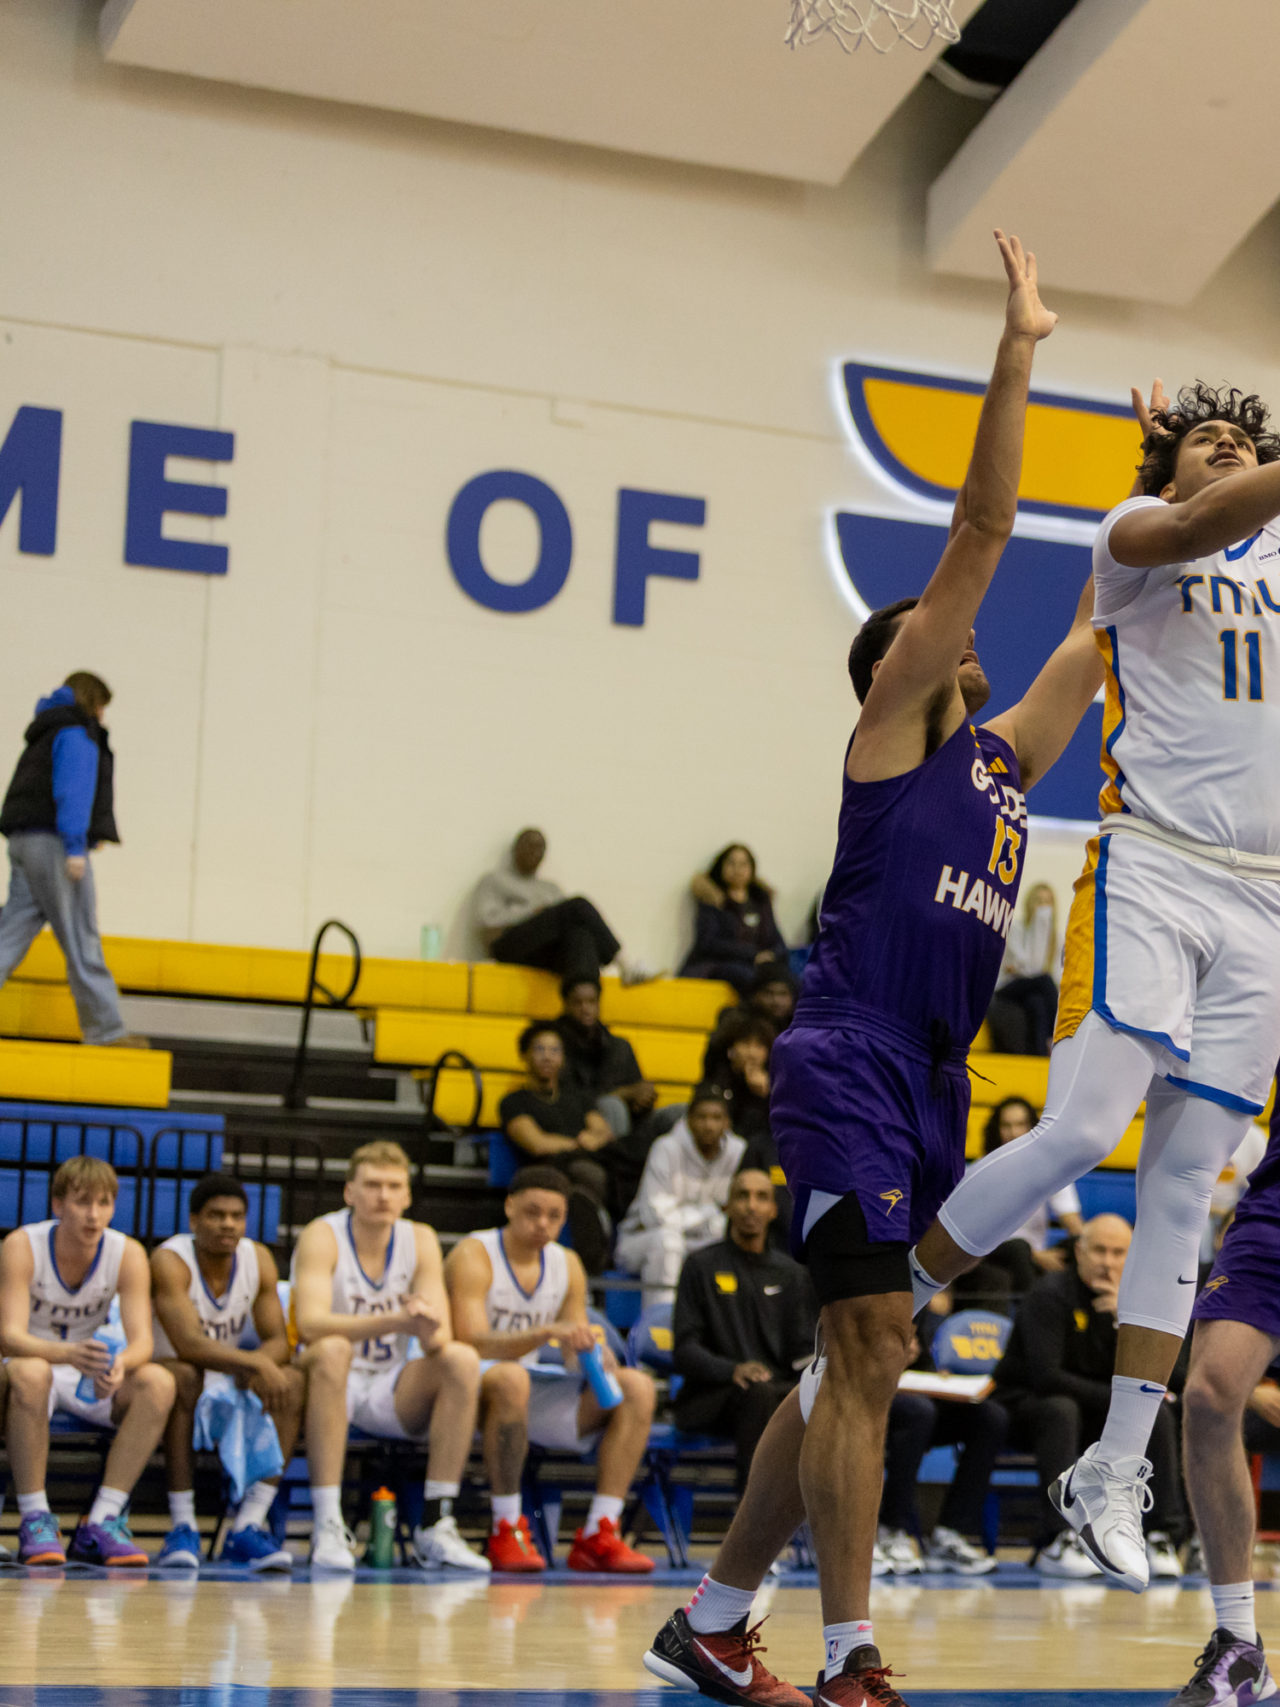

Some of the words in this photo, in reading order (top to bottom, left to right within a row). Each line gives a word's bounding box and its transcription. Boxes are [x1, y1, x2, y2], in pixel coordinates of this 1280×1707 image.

[0, 405, 235, 576] ME
[445, 468, 706, 628] OF
[1218, 628, 1264, 702] 11
[988, 814, 1022, 886] 13
